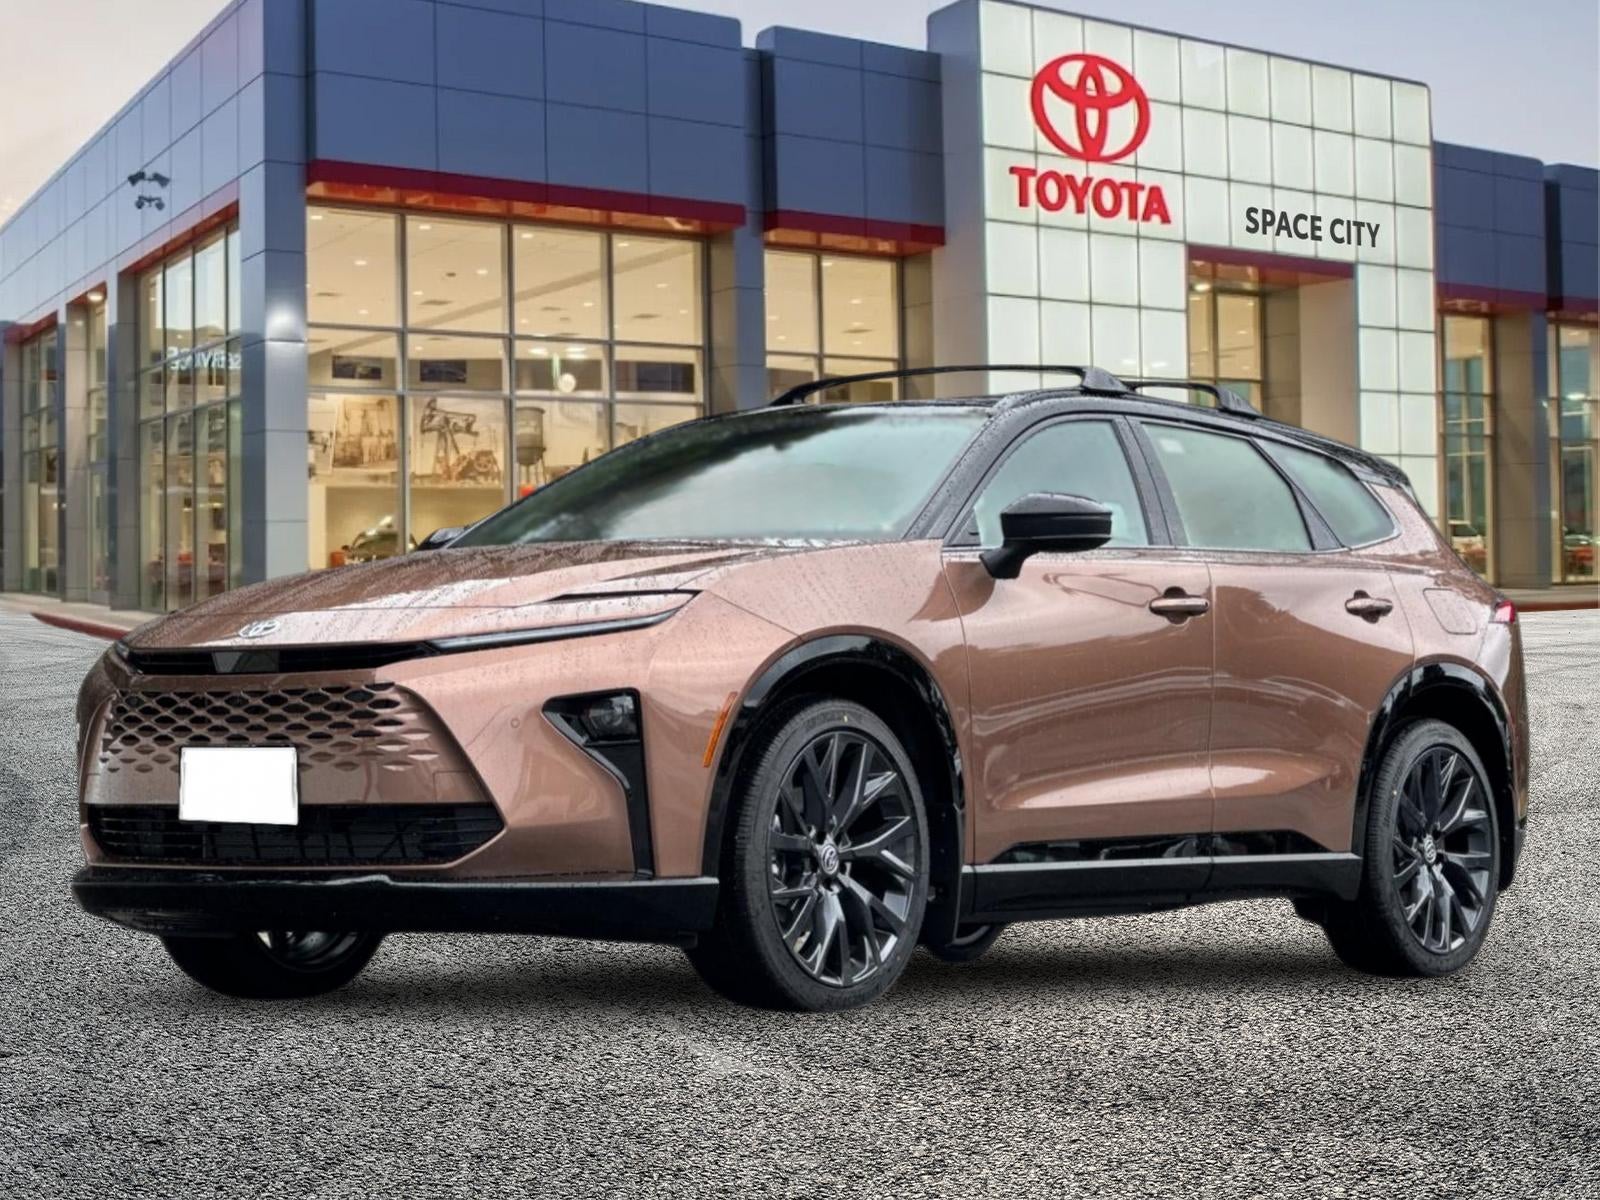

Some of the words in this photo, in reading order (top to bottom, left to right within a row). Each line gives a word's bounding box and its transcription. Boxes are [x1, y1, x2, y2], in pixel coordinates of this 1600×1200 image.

[1009, 165, 1172, 225] TOYOTA
[1245, 206, 1323, 242] SPACE
[1329, 218, 1381, 248] CITY
